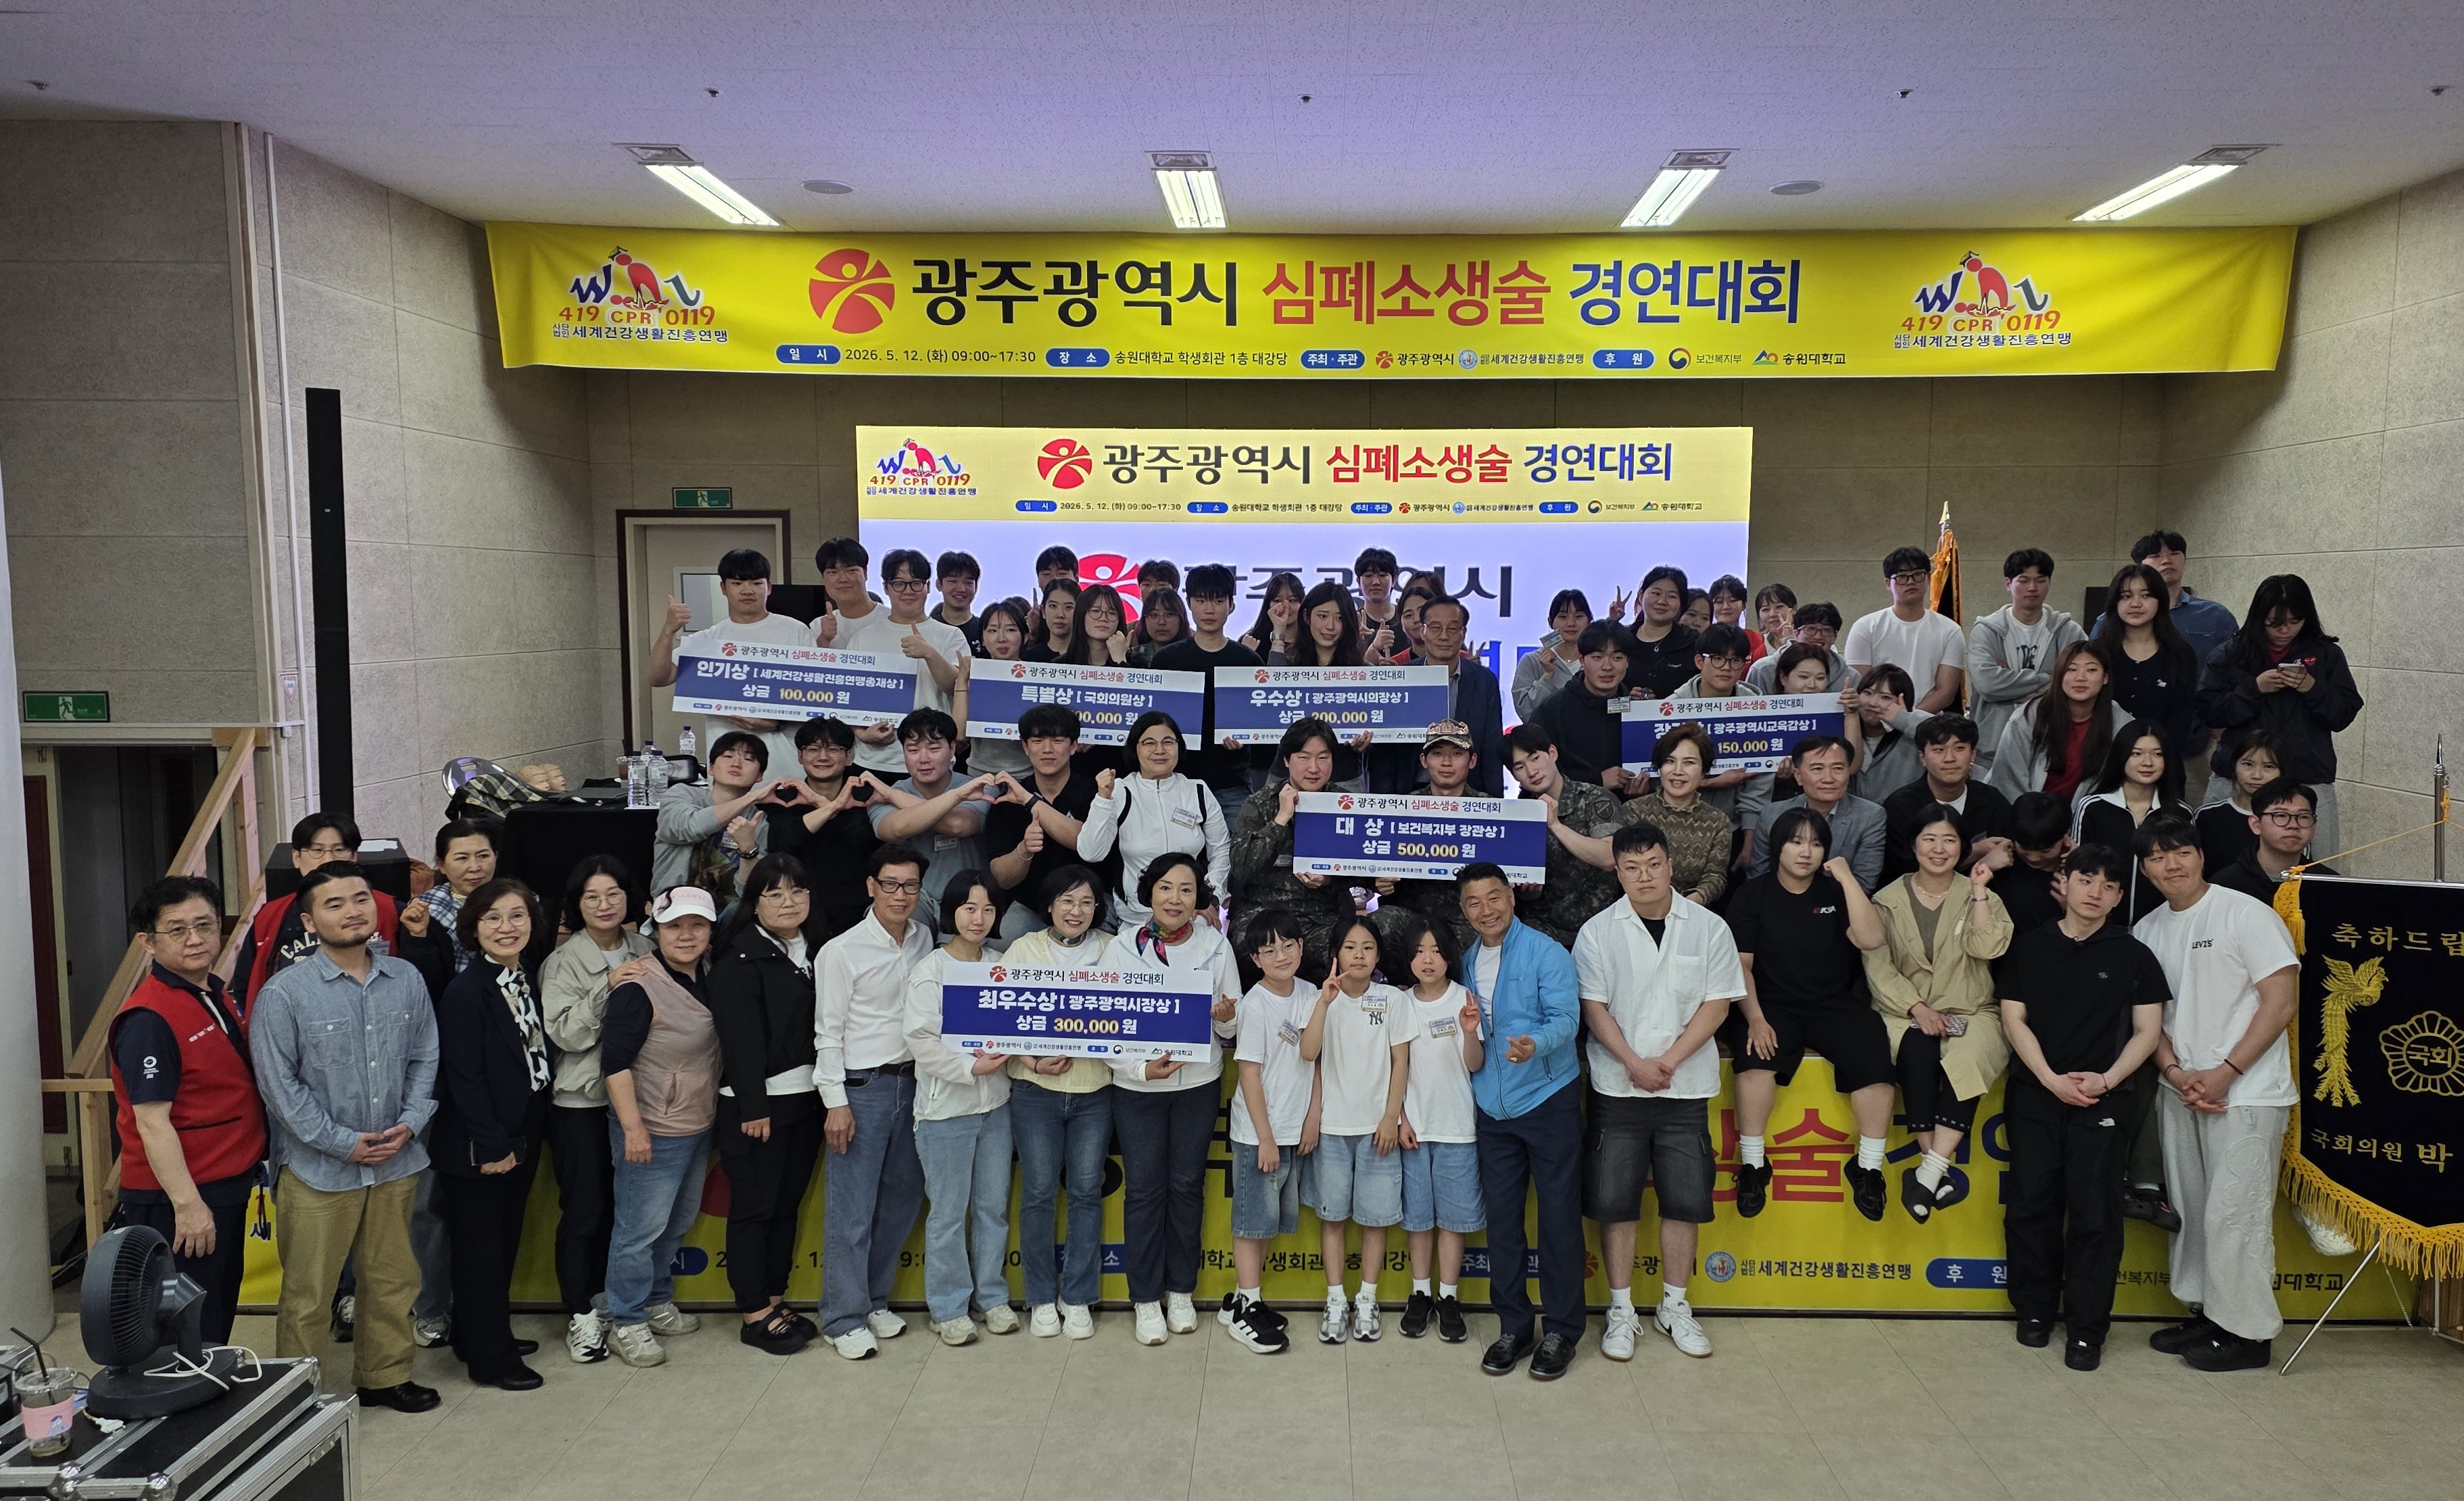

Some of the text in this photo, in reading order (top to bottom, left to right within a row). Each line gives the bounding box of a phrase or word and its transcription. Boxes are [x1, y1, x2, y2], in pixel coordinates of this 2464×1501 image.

[913, 258, 1801, 327] 광주광역시 심폐소생술 경연대회
[559, 305, 715, 326] 419 CPR 0119
[1902, 310, 2061, 332] 419 CPR 0119
[572, 325, 728, 343] 세계건강생활진흥연맹
[1912, 333, 2071, 347] 세계건강생활진흥연맹
[845, 349, 882, 361] 2026.
[904, 349, 923, 361] 12.
[927, 348, 948, 363] (화)
[952, 349, 1036, 362] 09:00~17:30
[1114, 350, 1288, 366] 송원대학교 학생회관 1층 대강당
[1397, 353, 1454, 366] 광주광역시
[1491, 353, 1584, 364] 세계건강생활진흥연맹
[1696, 353, 1742, 364] 보건복지부
[1783, 352, 1847, 365] 송원대학교
[1103, 443, 1672, 485] 광주광역시 심폐소생술 경연대회
[870, 473, 971, 486] 419 CPR 0119
[878, 487, 977, 495] 세계건강생활진흥연맹
[1232, 503, 1343, 513] 송원대학교 학생회관 1층 대강당
[1413, 503, 1451, 512] 광주광역시
[740, 645, 876, 665] 광주광역시 심폐소생술 경연대회
[696, 660, 749, 680] 인기상
[1028, 666, 1163, 684] 광주광역시 심폐소생술 경연대회
[1272, 669, 1405, 681] 광주광역시 심폐소생술 경연대회
[742, 684, 771, 698] 상금
[836, 691, 850, 705] 원
[1021, 685, 1073, 706] 특별상
[1250, 689, 1303, 707] 우수상
[1676, 697, 1804, 713] 광주광역시 심폐소생술 경연대회
[1370, 709, 1384, 723] 원
[1770, 738, 1783, 752] 원
[1357, 797, 1501, 813] 광주광역시 심폐소생술 경연대회
[1361, 840, 1476, 858] 상금 500,000 원
[1011, 968, 1163, 985] 광주광역시 심폐소생술 경연대회
[978, 990, 1056, 1011] 최우수상
[1016, 1015, 1137, 1035] 상금 300,000 원
[2407, 1044, 2453, 1068] 국회
[2311, 1128, 2453, 1174] 국회의원 박
[1758, 1260, 1912, 1279] 세계건강생활진흥연맹
